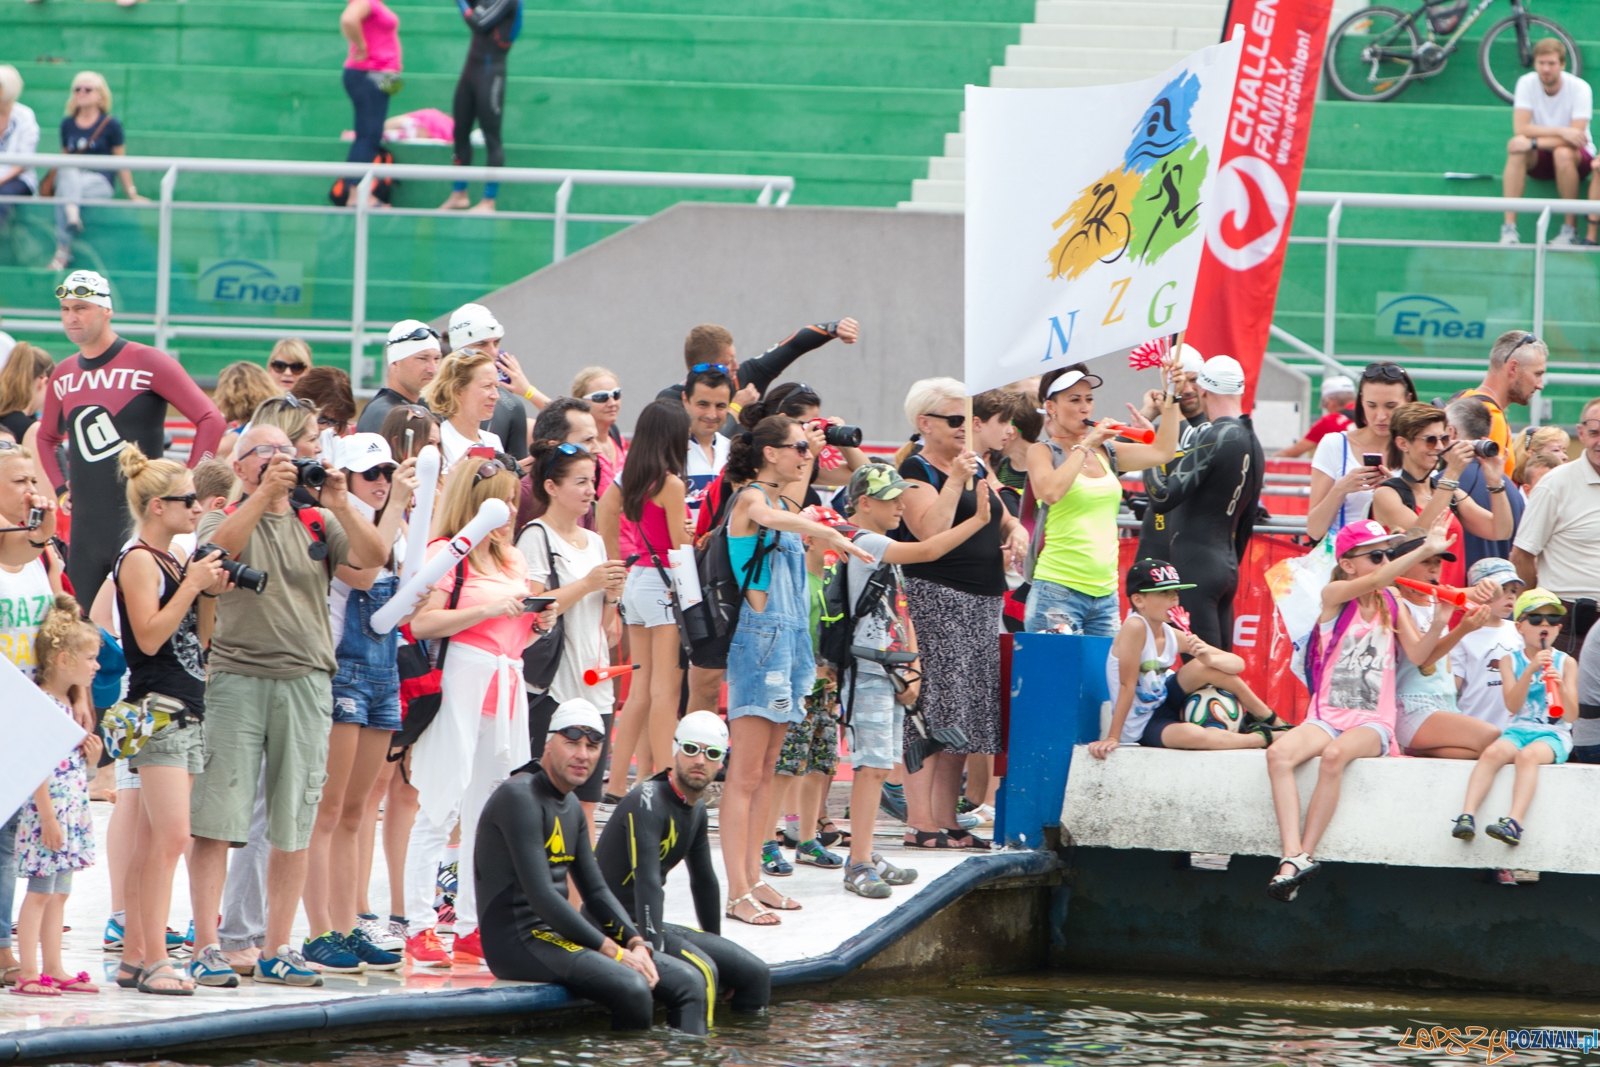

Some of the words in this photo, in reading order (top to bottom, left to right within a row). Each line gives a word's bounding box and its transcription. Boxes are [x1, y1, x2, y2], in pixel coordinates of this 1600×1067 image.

[1253, 56, 1288, 160] FAMILY
[214, 276, 301, 303] Enea
[1040, 309, 1080, 362] N
[1101, 276, 1132, 327] Z
[1147, 280, 1177, 329] G
[1393, 311, 1486, 339] Enea
